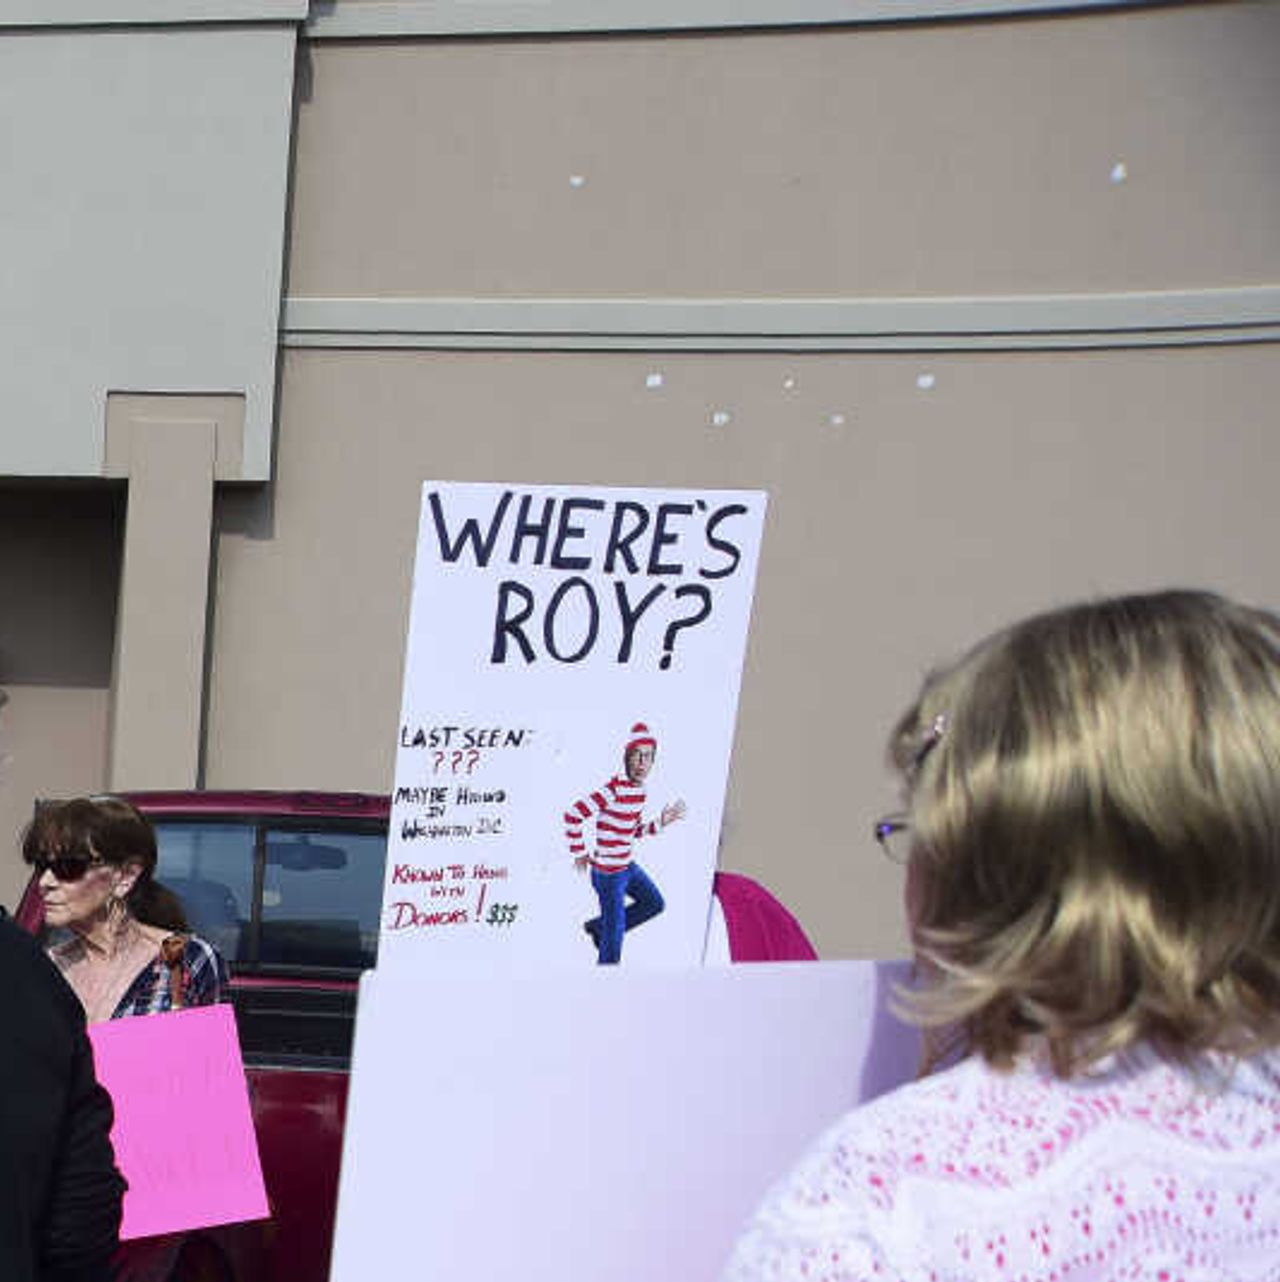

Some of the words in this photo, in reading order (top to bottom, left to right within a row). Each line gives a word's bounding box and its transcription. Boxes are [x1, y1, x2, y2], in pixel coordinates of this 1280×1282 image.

[428, 491, 748, 579] WHERE'S
[490, 576, 713, 670] ROY?
[401, 726, 458, 748] LAST
[394, 787, 448, 805] MAYBE
